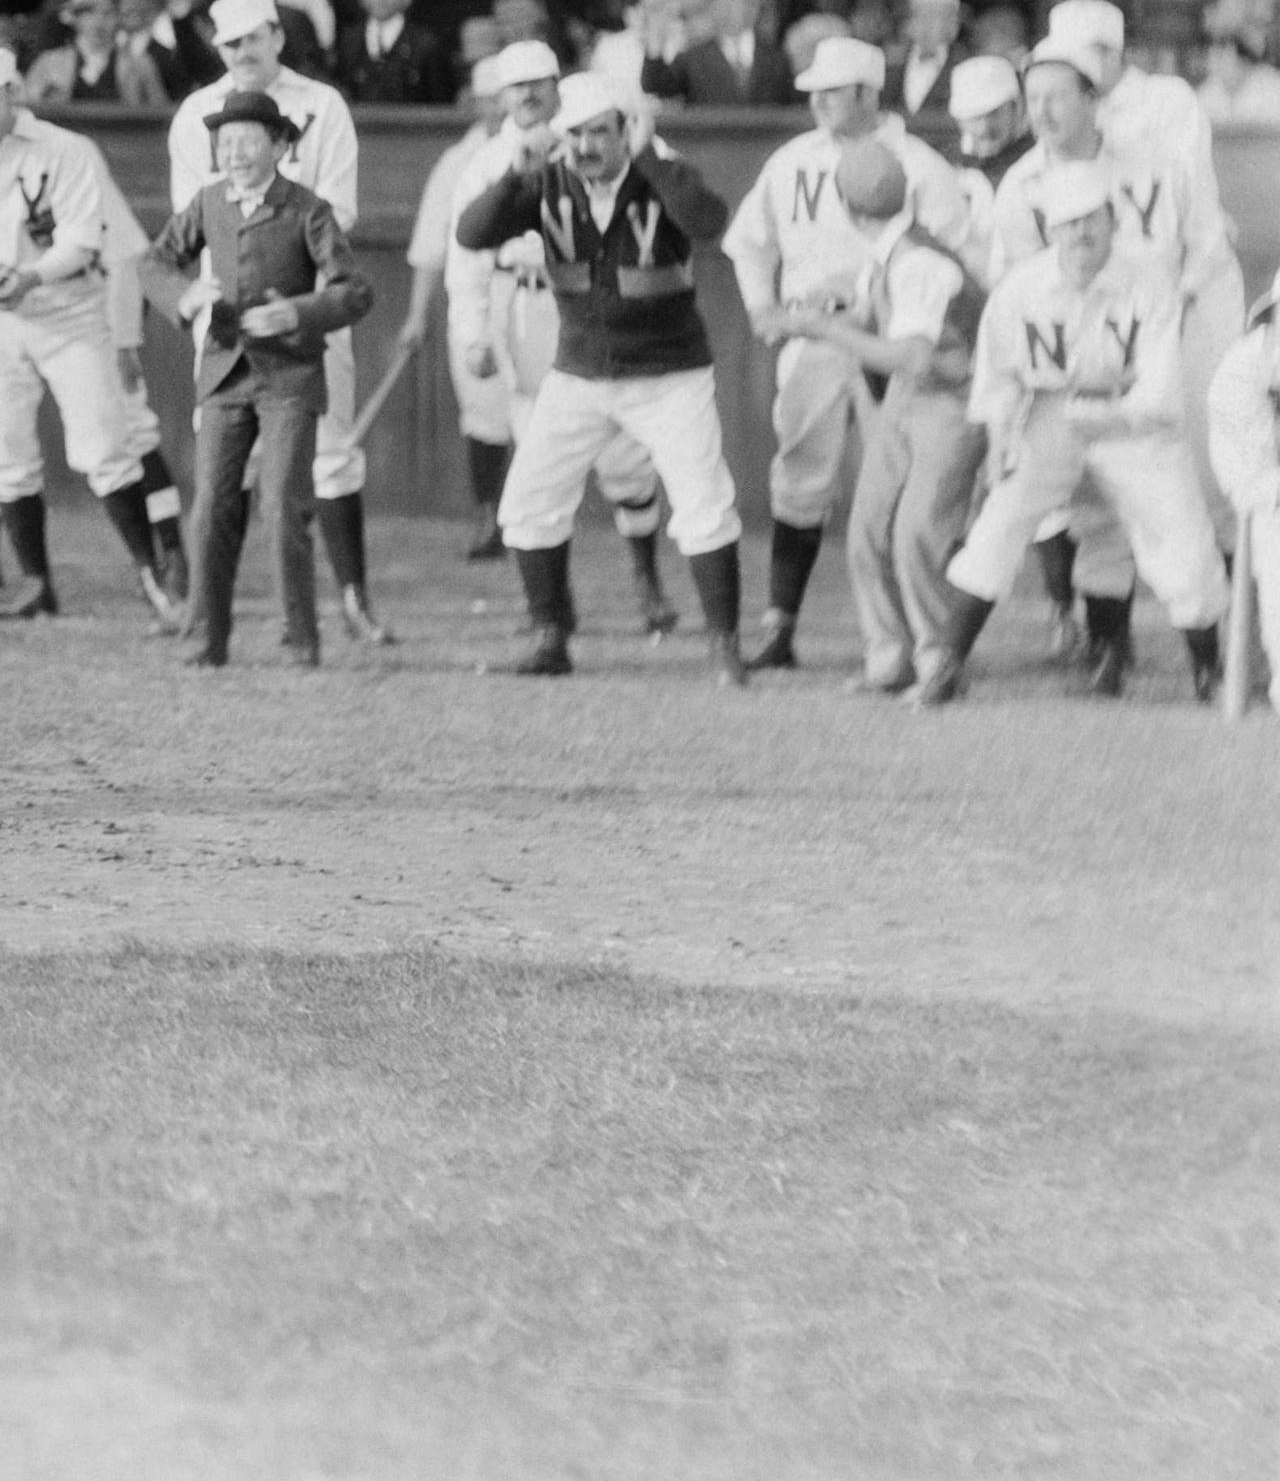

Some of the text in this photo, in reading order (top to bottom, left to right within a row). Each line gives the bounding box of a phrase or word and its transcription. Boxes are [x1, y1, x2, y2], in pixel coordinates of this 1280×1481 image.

[15, 172, 50, 226] Y
[791, 169, 828, 223] N
[1122, 181, 1161, 238] Y
[626, 198, 662, 268] Y
[1023, 316, 1140, 371] N Y
